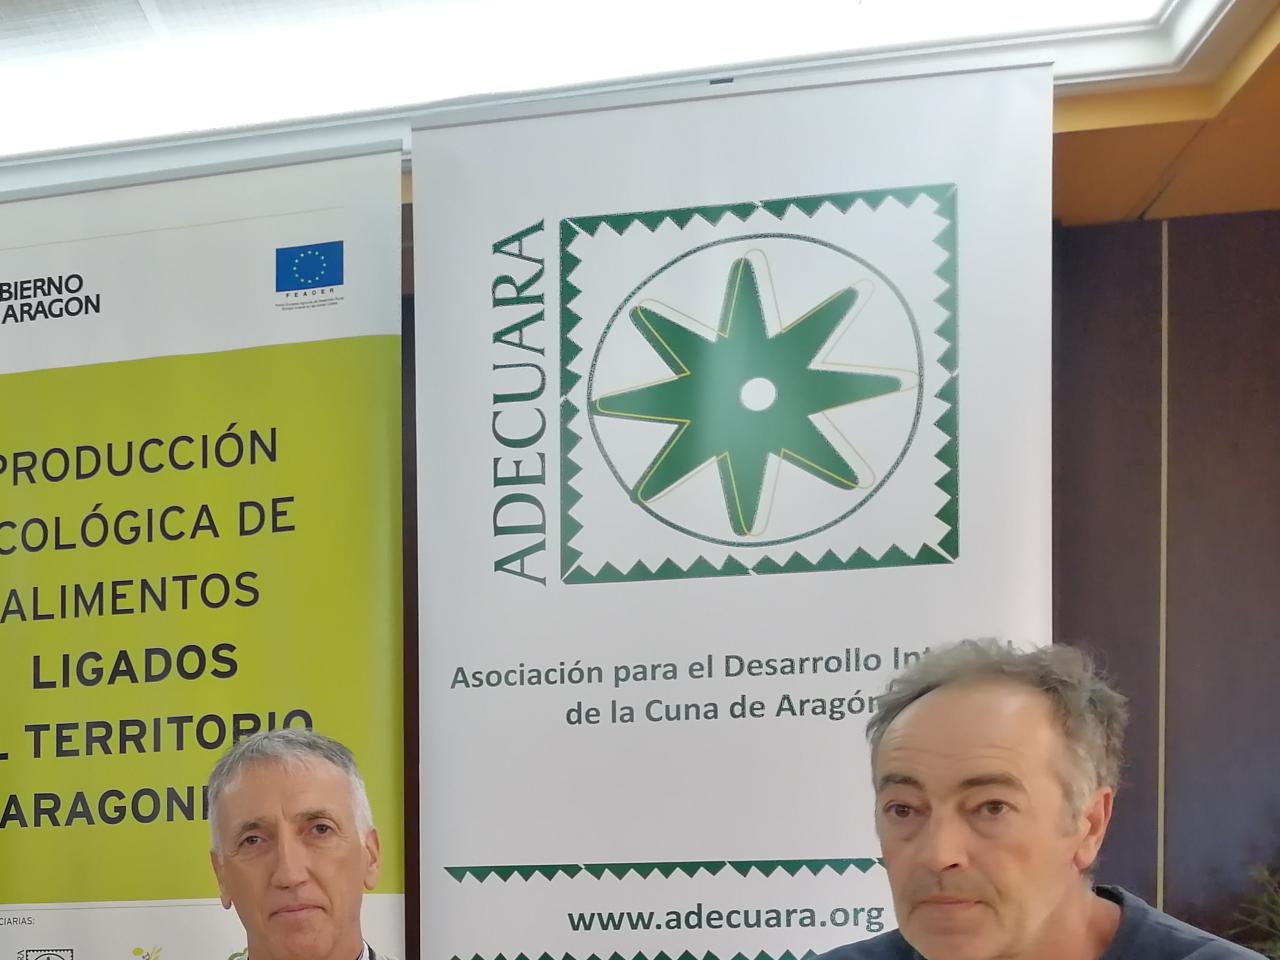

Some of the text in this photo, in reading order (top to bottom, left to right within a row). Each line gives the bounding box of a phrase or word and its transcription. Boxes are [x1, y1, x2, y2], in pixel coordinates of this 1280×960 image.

[1, 294, 101, 325] ARAGON
[492, 218, 547, 587] ADECUARA
[239, 496, 296, 537] DE
[0, 571, 261, 623] ALIMENTOS
[32, 643, 239, 690] LIGADOS
[450, 647, 931, 689] Asociación para el Desarrollo In
[565, 701, 601, 725] de
[611, 700, 636, 724] la
[644, 698, 719, 723] Cuna
[729, 694, 766, 719] de
[568, 902, 885, 933] www.adecuara.org
